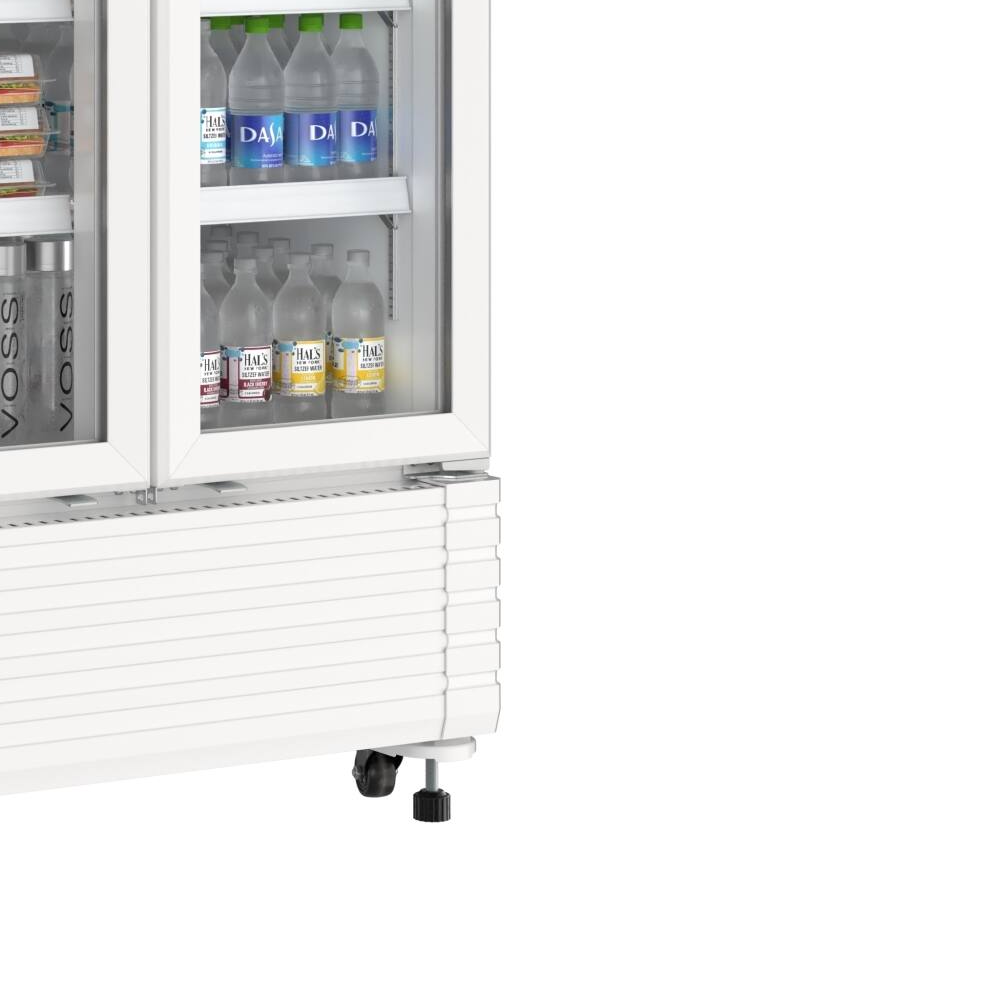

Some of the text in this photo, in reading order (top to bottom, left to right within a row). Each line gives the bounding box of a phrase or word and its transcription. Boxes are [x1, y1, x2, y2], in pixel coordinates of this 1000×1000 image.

[245, 353, 268, 367] HAL'S
[296, 347, 320, 361] HAL'S
[1, 297, 19, 438] VOSS
